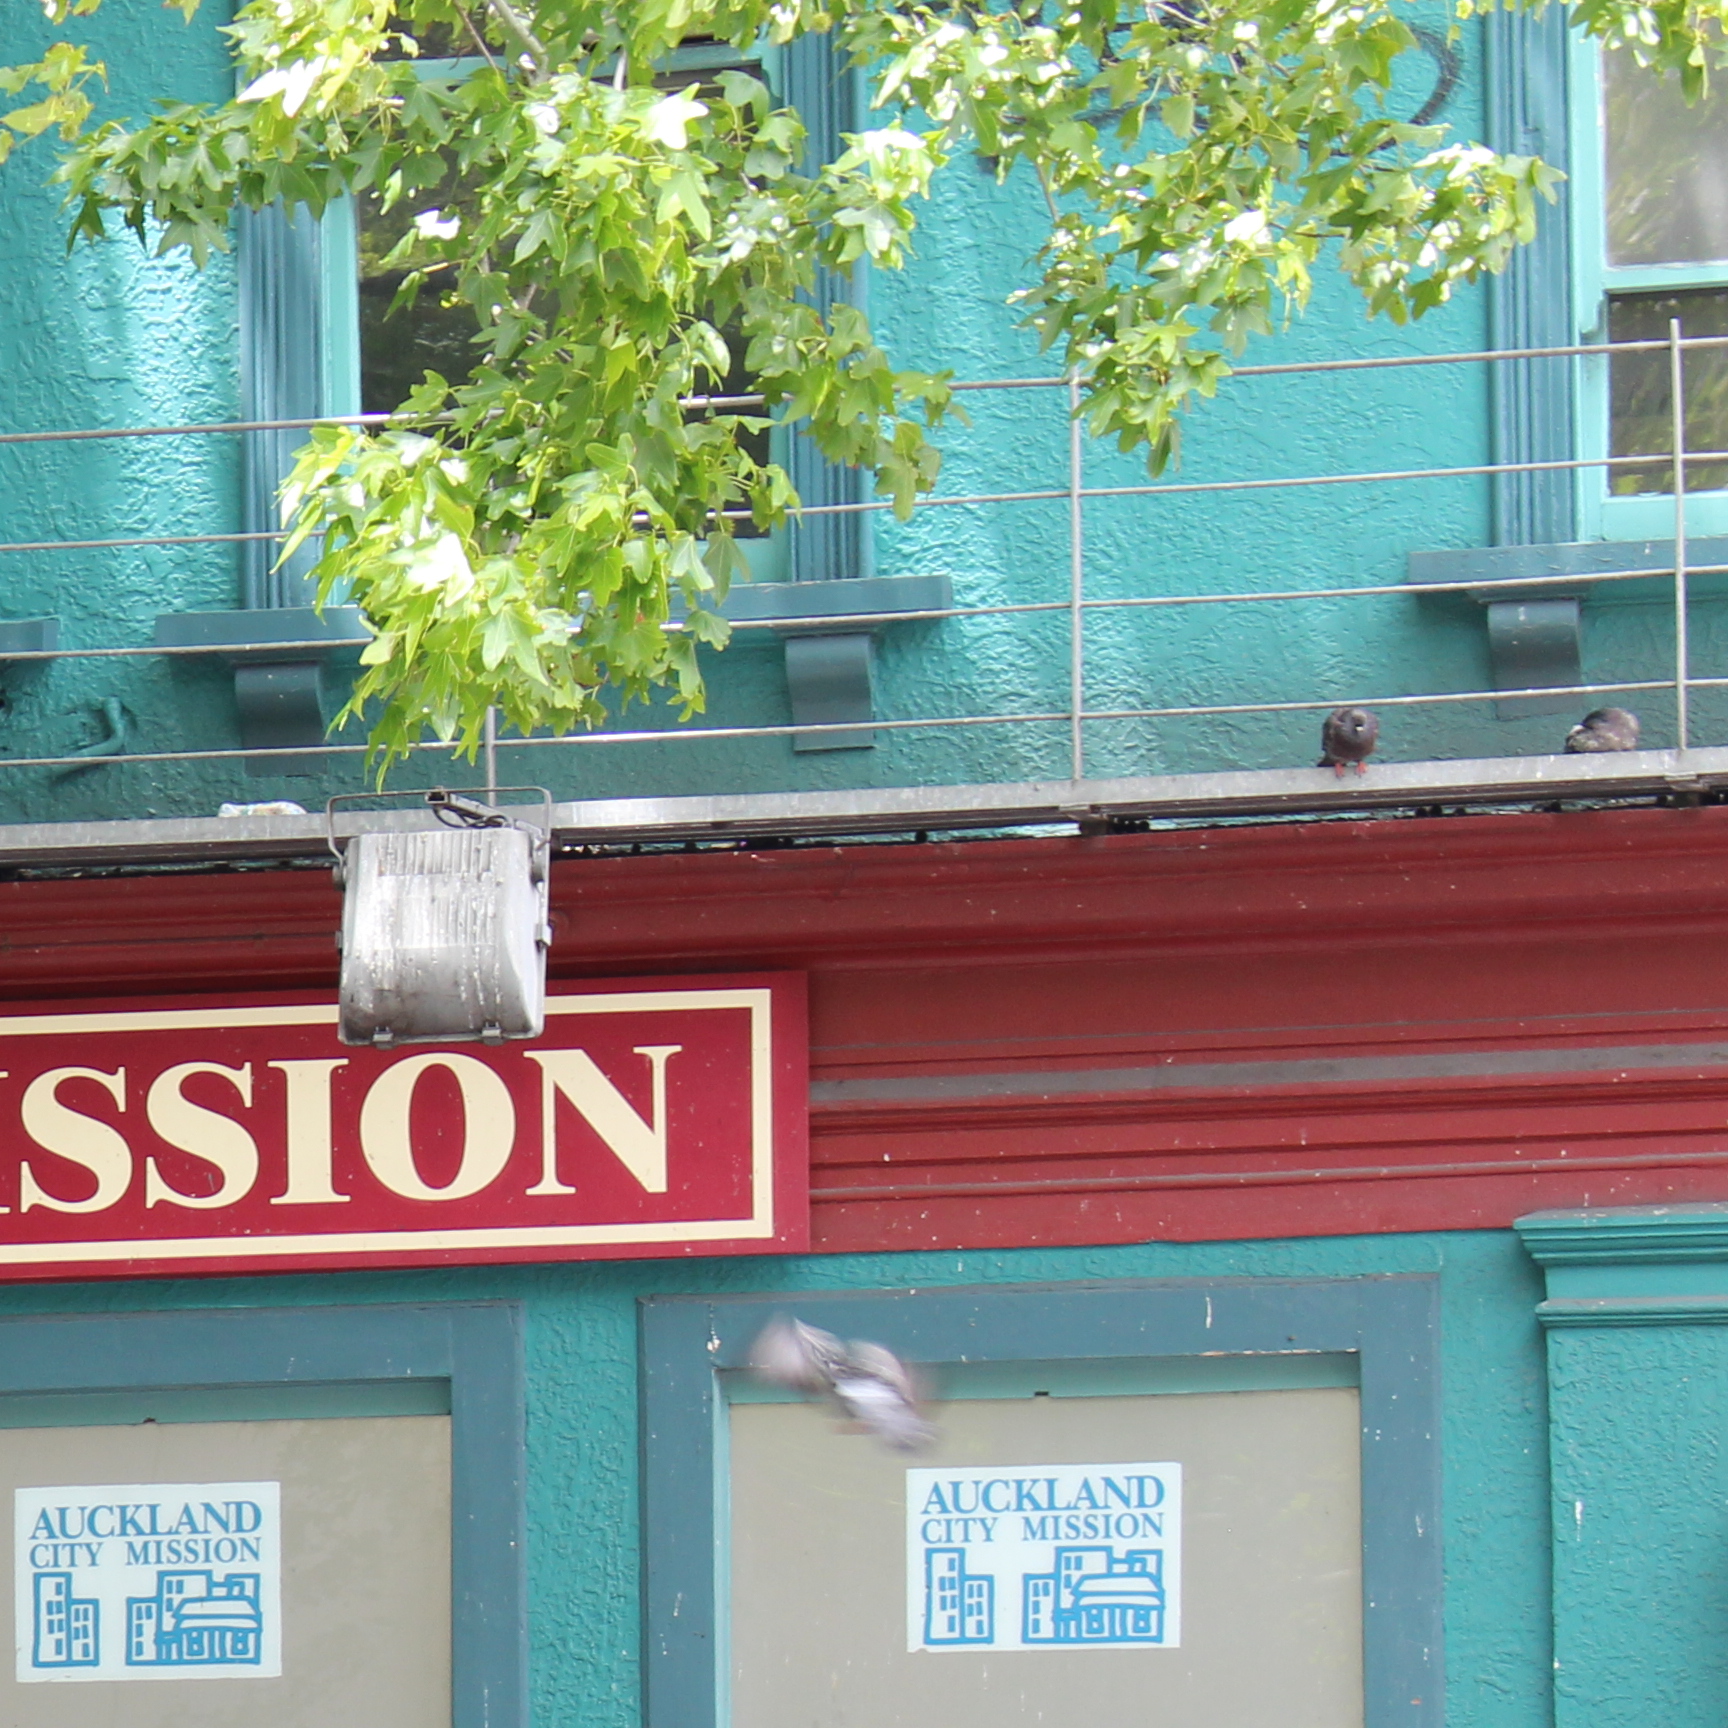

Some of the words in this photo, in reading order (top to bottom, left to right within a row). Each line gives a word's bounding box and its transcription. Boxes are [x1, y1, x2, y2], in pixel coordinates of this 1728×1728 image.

[920, 1475, 1165, 1515] AUCKLAND
[28, 1500, 262, 1540] AUCKLAND
[920, 1516, 999, 1544] CITY
[1022, 1512, 1164, 1541] MISSION
[29, 1541, 104, 1569] CITY
[125, 1536, 262, 1566] MISSION
